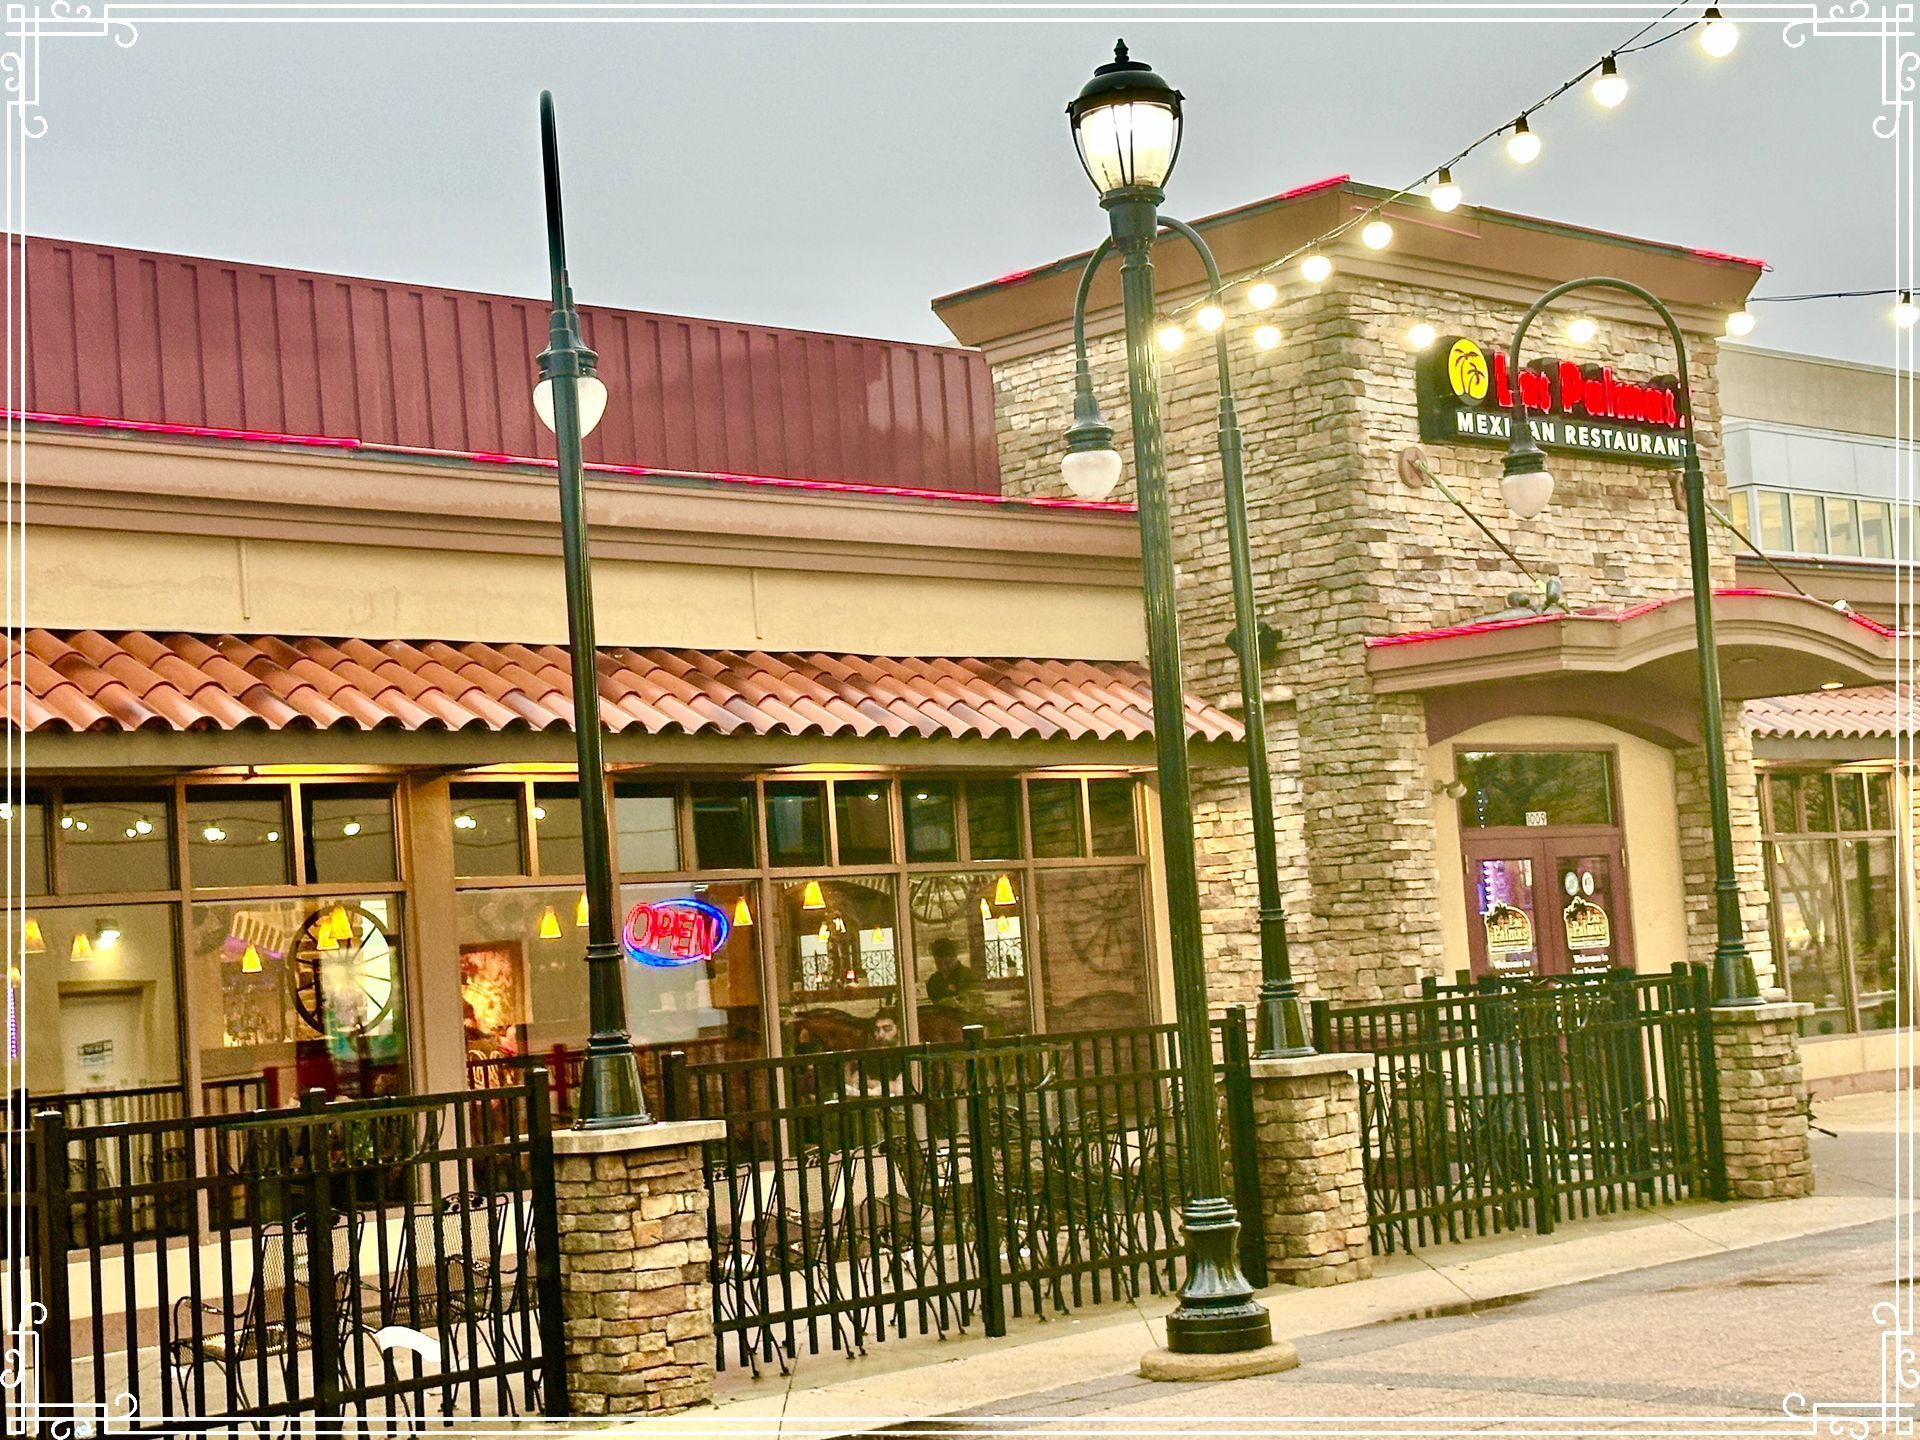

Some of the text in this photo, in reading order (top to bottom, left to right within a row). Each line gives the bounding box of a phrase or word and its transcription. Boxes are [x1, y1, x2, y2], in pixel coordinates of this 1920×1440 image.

[1494, 352, 1551, 414] Las
[1559, 360, 1676, 428] Palmas
[1456, 411, 1555, 442] MEXIAN
[1526, 812, 1545, 825] 1009
[626, 903, 718, 960] OPEN
[1492, 925, 1527, 941] Palmas
[1571, 920, 1605, 936] Palmas
